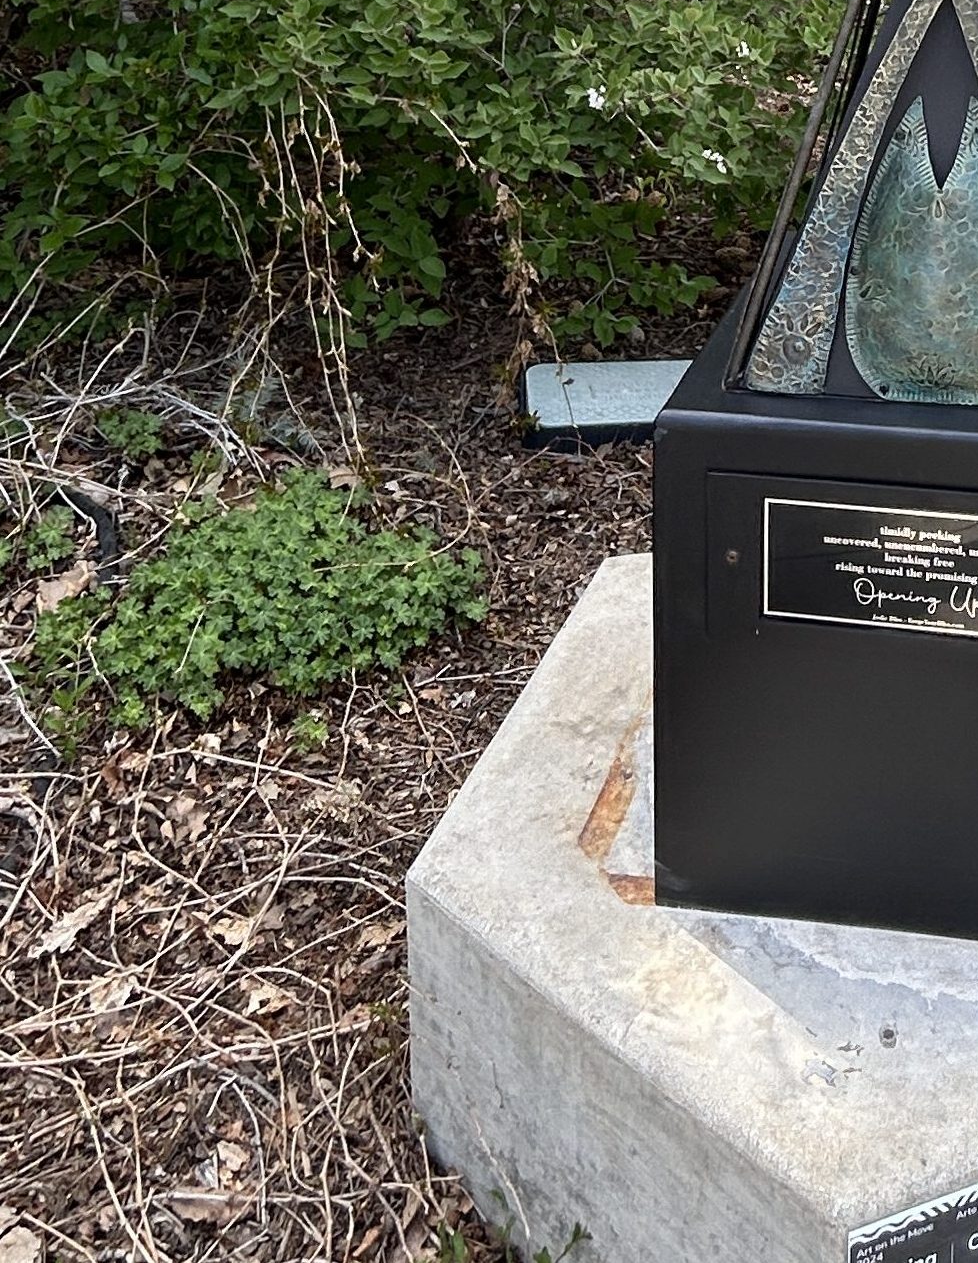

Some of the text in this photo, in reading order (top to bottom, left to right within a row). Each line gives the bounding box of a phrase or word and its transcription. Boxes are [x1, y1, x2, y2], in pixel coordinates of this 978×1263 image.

[823, 536, 882, 550] uncovered,
[880, 525, 962, 544] timidly peeking
[884, 552, 955, 568] breaking free
[835, 562, 865, 575] rising
[867, 565, 904, 577] toward
[905, 568, 923, 578] the
[925, 571, 978, 586] promising
[853, 577, 941, 615] Opening
[956, 1206, 977, 1221] Arte
[856, 1222, 935, 1259] Art on the Move
